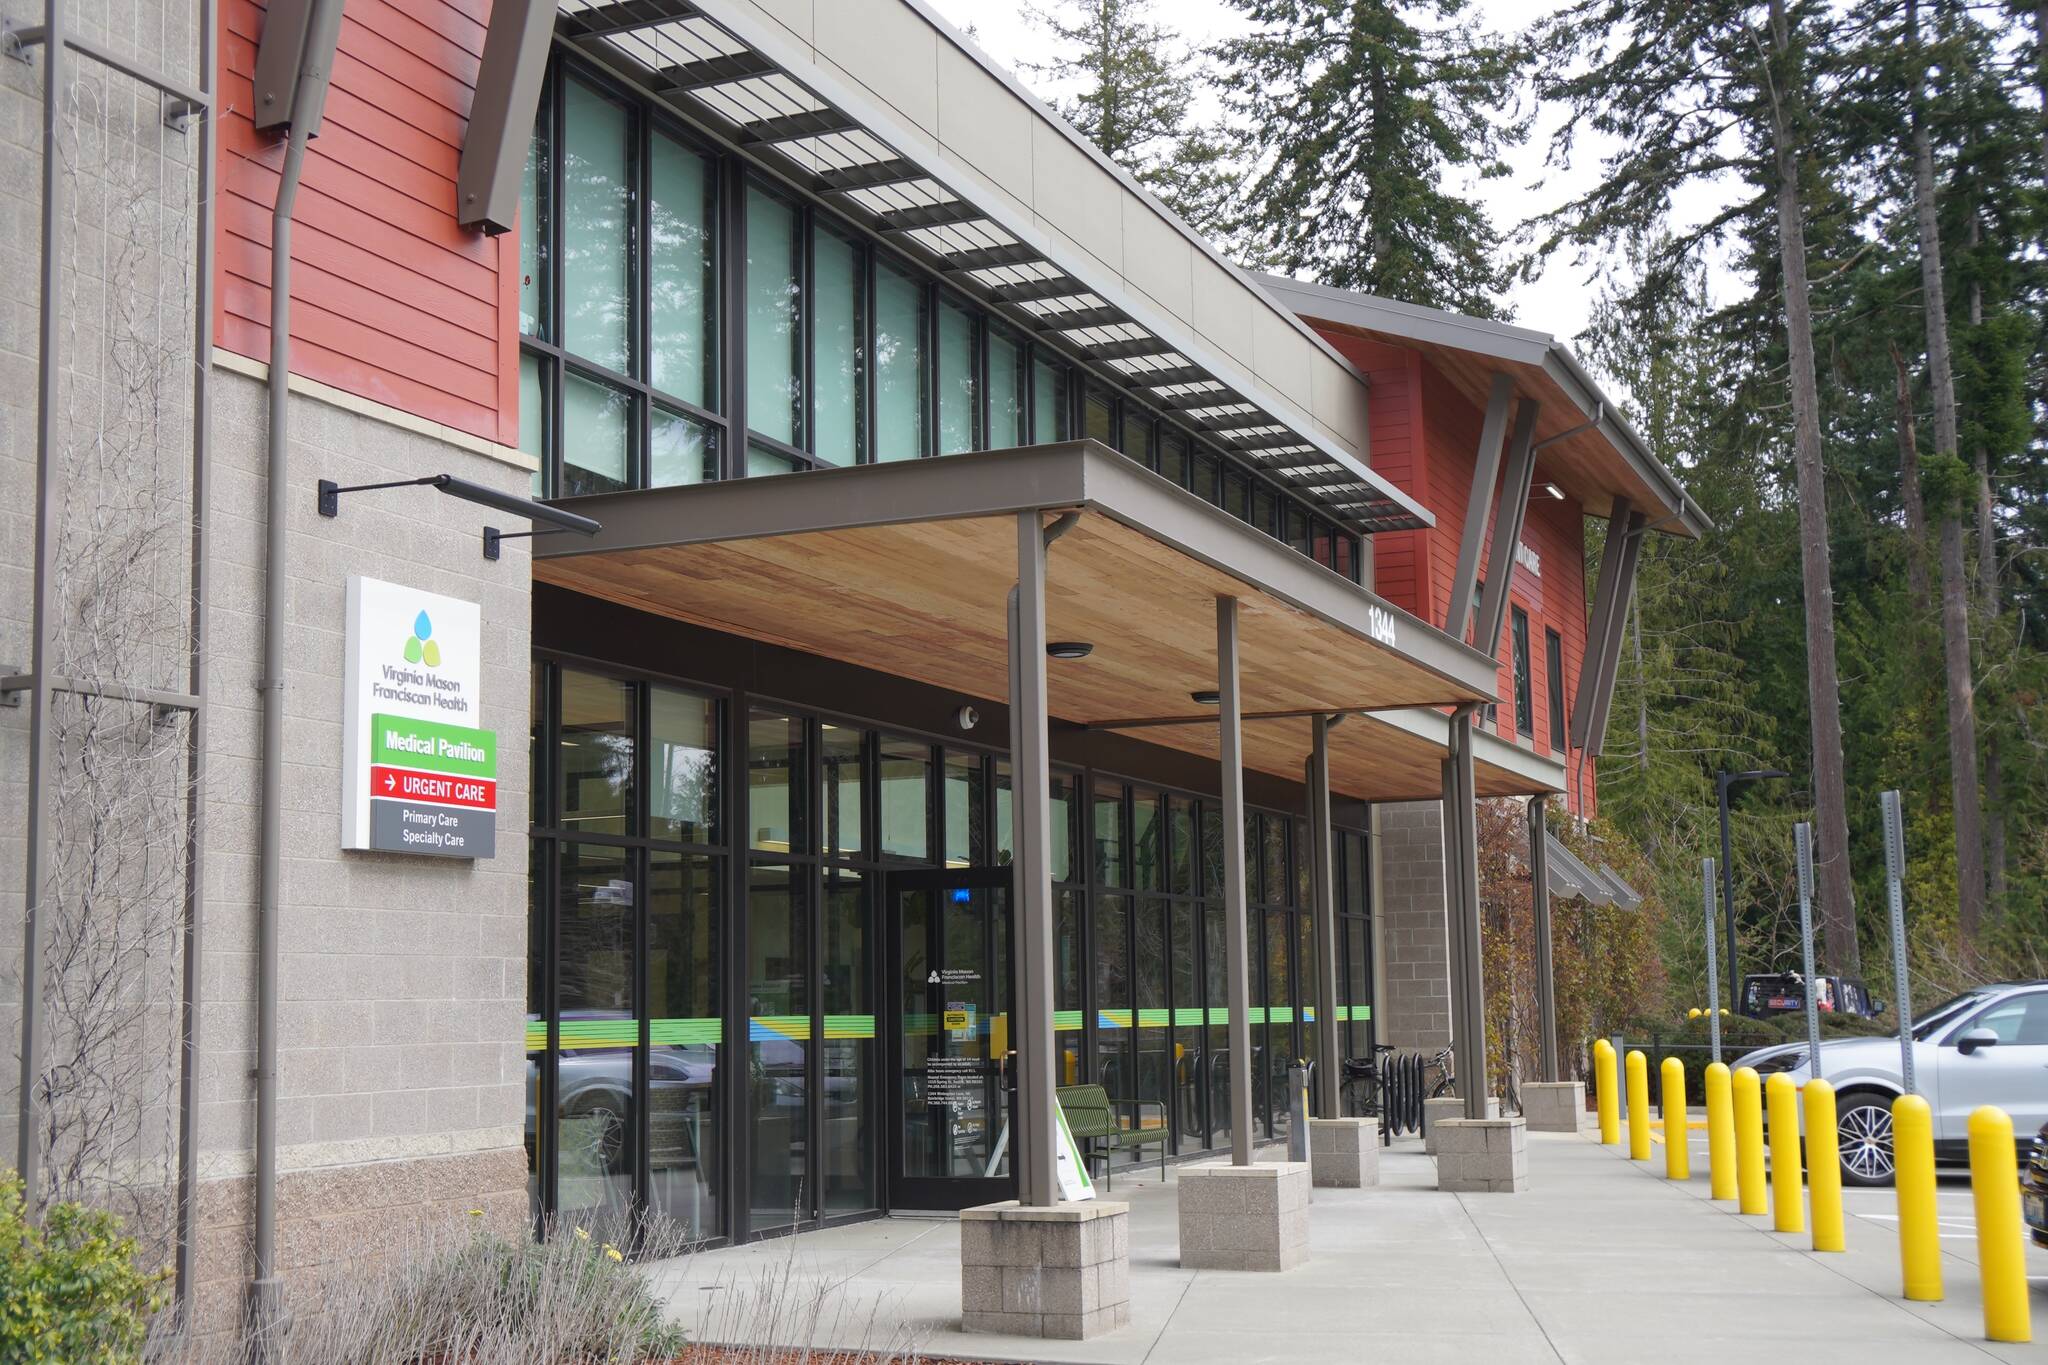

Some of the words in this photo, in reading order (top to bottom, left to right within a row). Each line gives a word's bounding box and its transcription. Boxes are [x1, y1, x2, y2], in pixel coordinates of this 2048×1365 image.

[1369, 604, 1395, 647] 1344
[382, 664, 423, 686] Virginia
[426, 673, 460, 692] Mason
[373, 682, 431, 706] Franciscan
[433, 692, 468, 712] Health
[385, 730, 435, 756] Medical
[438, 738, 485, 762] Pavilion
[403, 776, 452, 798] URGENT
[455, 783, 486, 802] CARE
[403, 809, 437, 827] Primary
[438, 813, 458, 827] Care
[403, 829, 444, 847] Specialty
[444, 833, 465, 847] Care
[1768, 998, 1799, 1007] SECURITY
